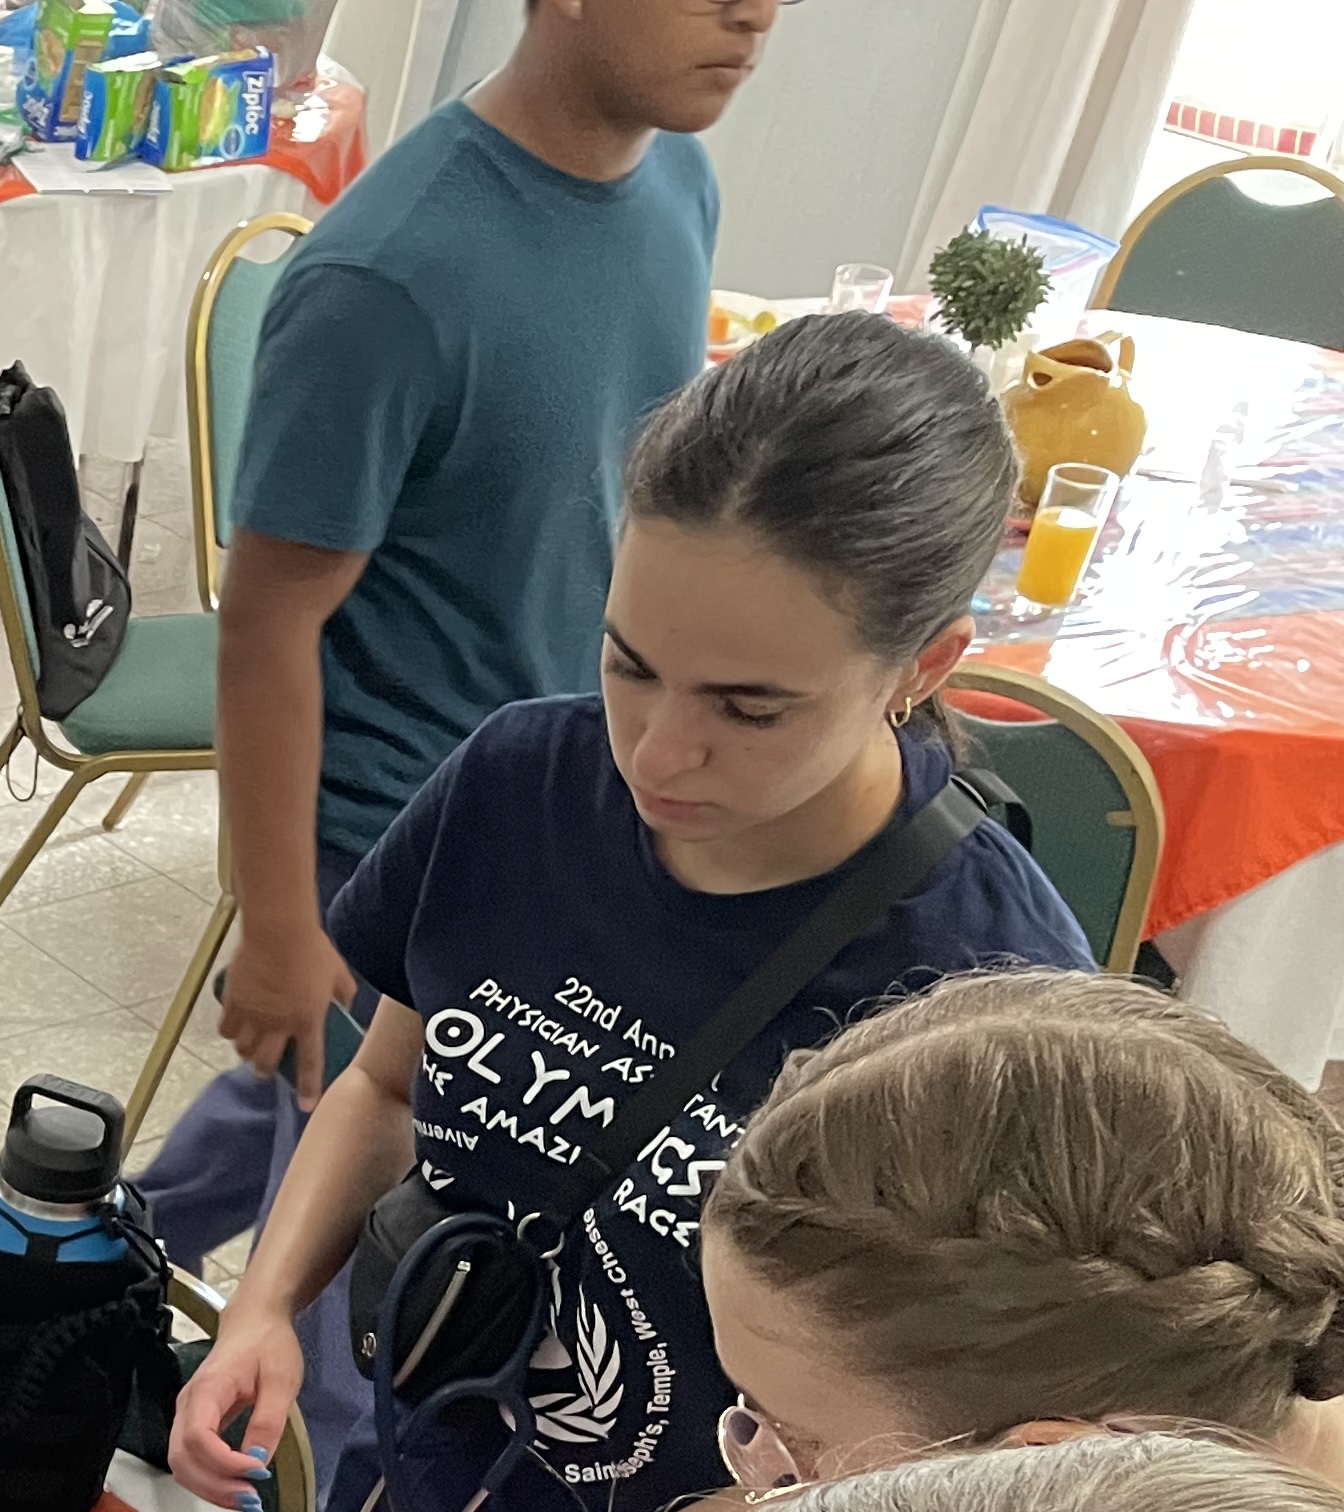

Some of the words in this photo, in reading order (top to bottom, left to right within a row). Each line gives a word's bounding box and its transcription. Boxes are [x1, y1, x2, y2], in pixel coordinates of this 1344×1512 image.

[242, 75, 265, 136] Ziploc
[554, 976, 622, 1031] 22nd
[469, 978, 601, 1058] PHYSICIAN
[601, 1057, 746, 1149] ASTAN
[425, 1008, 727, 1196] OLYMICS
[422, 1052, 454, 1096] HE
[460, 1096, 582, 1165] AMAZI
[612, 1177, 700, 1247] RACE
[583, 1207, 627, 1284] Cheste
[620, 1288, 657, 1340] West
[646, 1342, 676, 1415] Temple,
